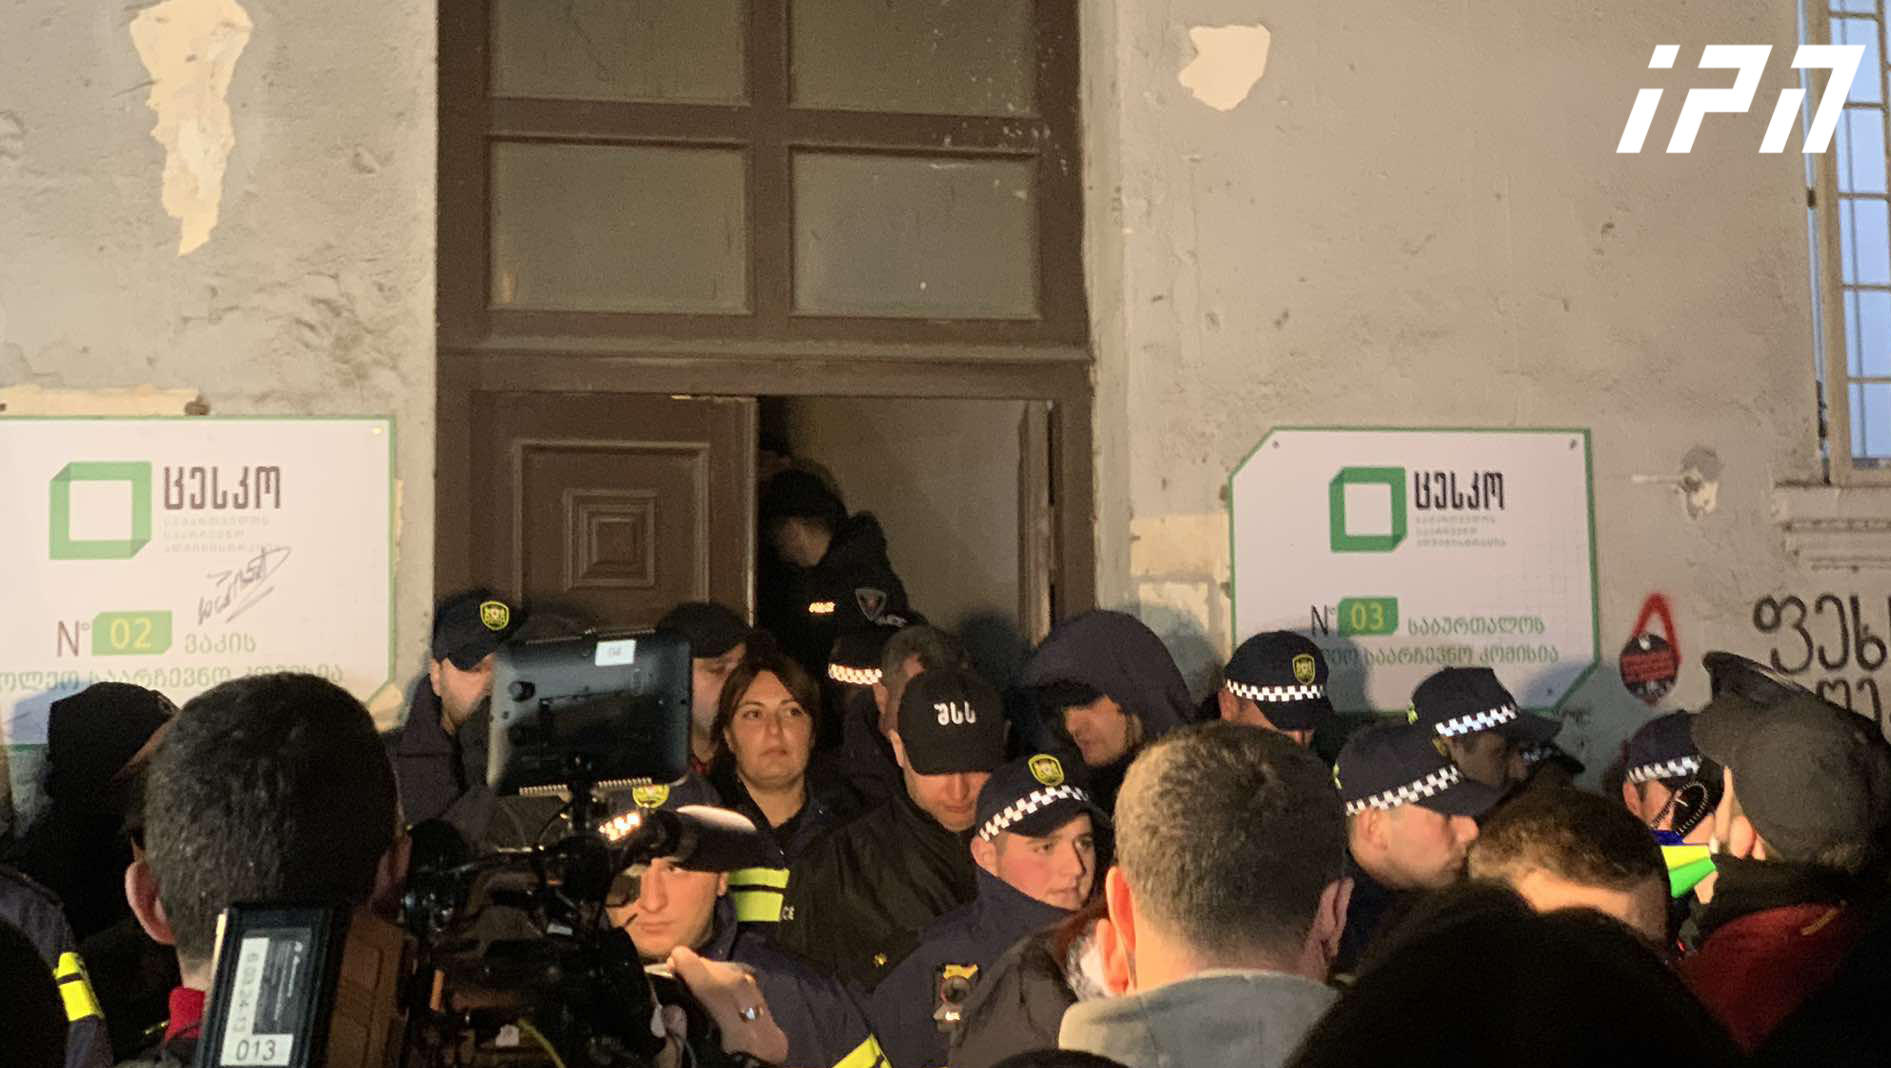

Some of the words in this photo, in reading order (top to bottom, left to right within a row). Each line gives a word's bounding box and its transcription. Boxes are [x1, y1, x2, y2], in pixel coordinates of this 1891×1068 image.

[164, 466, 280, 509] ცესკო
[1414, 471, 1504, 510] ცესკო
[110, 617, 153, 650] 02
[184, 632, 257, 655] ვაკის
[1351, 600, 1384, 631] 03
[1407, 615, 1546, 636] საბურთალოს
[1753, 594, 1891, 675] ფეხ
[1480, 642, 1559, 666] კომისია
[933, 701, 977, 726] შსს
[235, 1039, 277, 1062] 013
